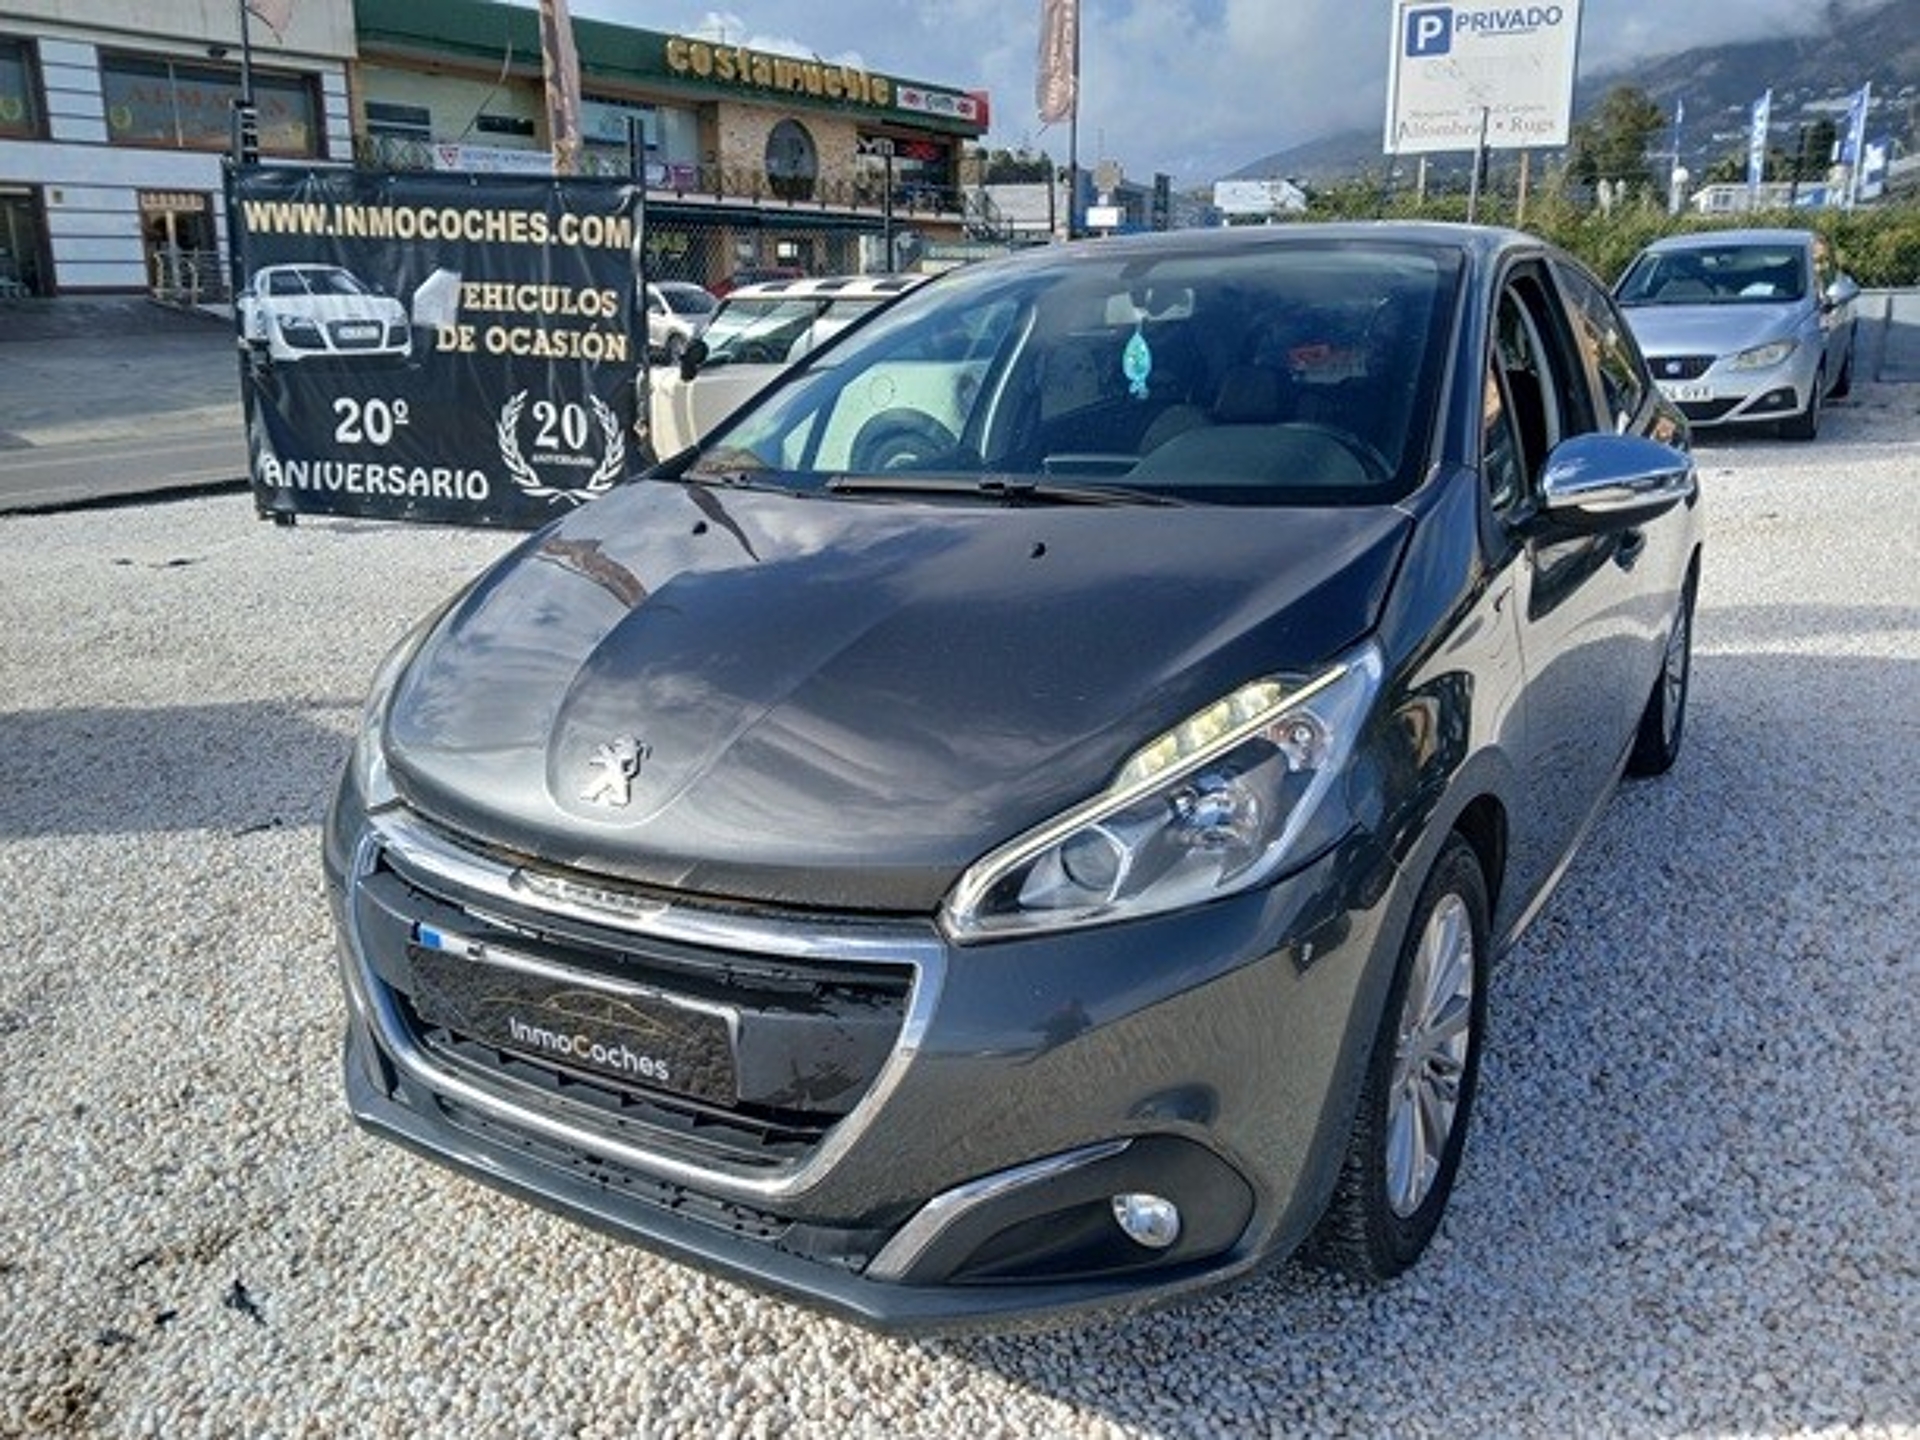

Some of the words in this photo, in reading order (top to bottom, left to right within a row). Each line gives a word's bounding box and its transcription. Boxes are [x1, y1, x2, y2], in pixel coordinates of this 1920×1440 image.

[1417, 15, 1444, 50] P
[1455, 6, 1563, 32] PRIVADO
[243, 201, 632, 249] WWW.INMOCOCHES.COM
[437, 326, 475, 353] DE
[485, 323, 628, 363] OCASIÓN
[532, 400, 589, 451] 20
[263, 456, 490, 500] ANIVERSARIO
[508, 1016, 670, 1081] InmoCoches
